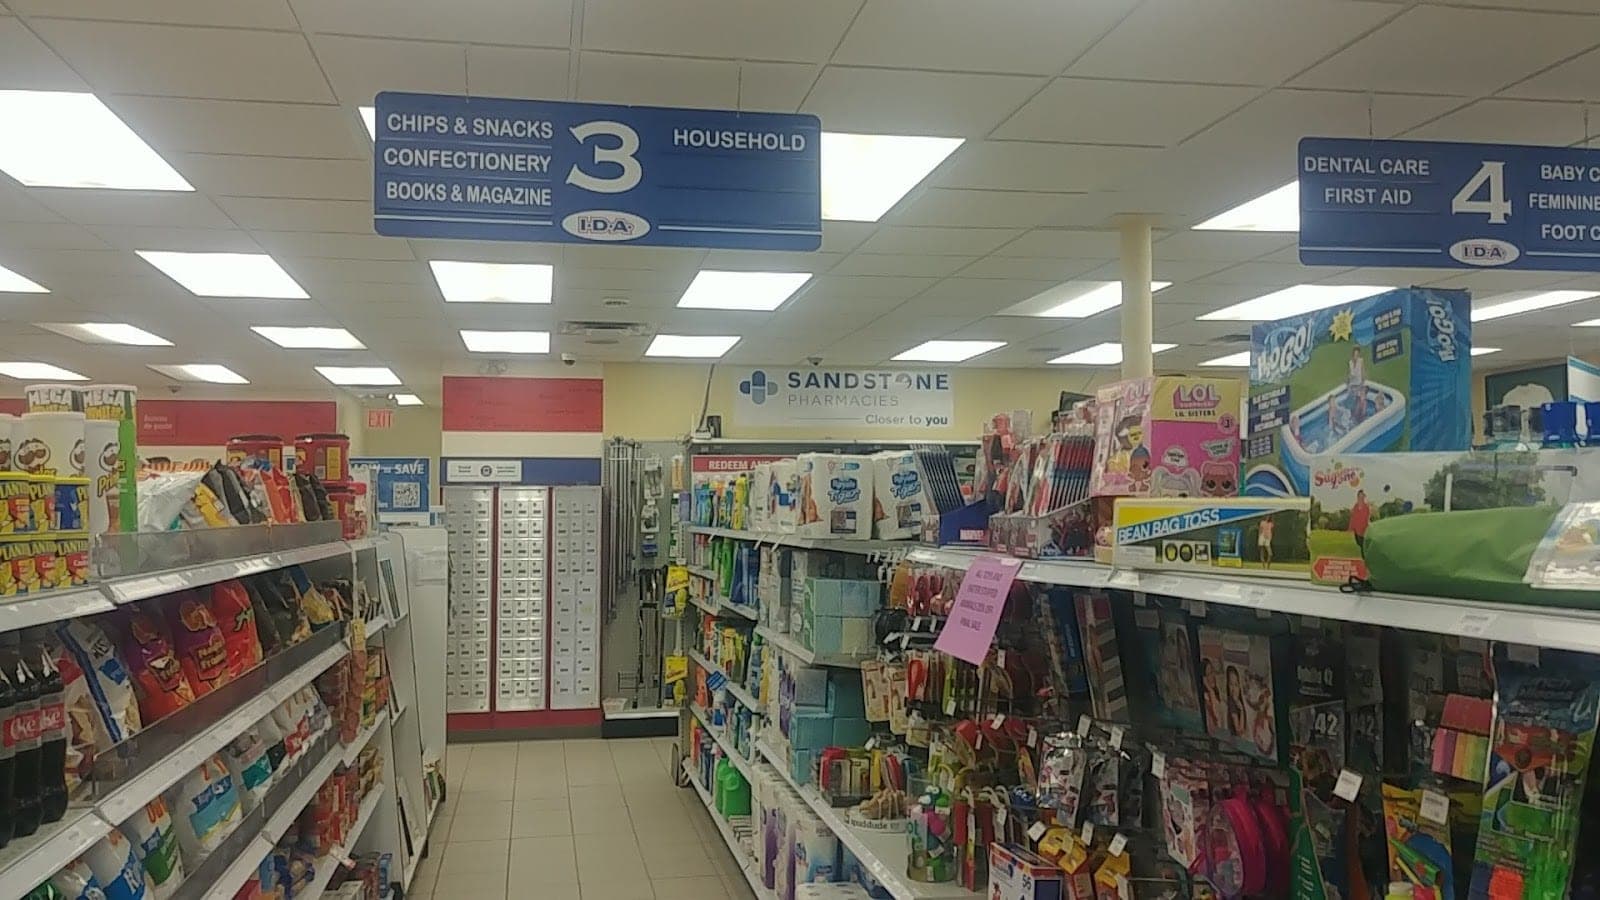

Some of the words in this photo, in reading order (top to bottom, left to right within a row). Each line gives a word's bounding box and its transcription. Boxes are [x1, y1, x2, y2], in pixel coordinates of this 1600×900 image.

[387, 113, 449, 134] CHIPS
[453, 117, 469, 133] &
[473, 118, 554, 139] SNACKS
[673, 128, 806, 152] HOUSEHOLD
[383, 147, 552, 174] CONFECTIONERY
[565, 120, 643, 194] 3
[1304, 157, 1376, 175] DENTAL
[1380, 159, 1430, 176] CARE
[1541, 165, 1586, 182] BABY
[386, 182, 447, 202] BOOKS
[451, 185, 463, 202] &
[466, 186, 552, 206] MAGAZINE
[1325, 188, 1377, 205] FIRST
[1381, 188, 1412, 205] AID
[1452, 161, 1512, 224] 4
[1542, 224, 1587, 240] FOOT
[788, 372, 949, 390] SANDSTONE
[788, 394, 899, 407] PHARMACIES
[368, 410, 392, 428] EXIT
[865, 415, 905, 425] Closer
[909, 415, 922, 425] to
[926, 416, 948, 427] you
[394, 463, 425, 475] SAVE
[708, 460, 748, 470] REDEEM
[1118, 523, 1151, 543] BEAN
[1153, 515, 1180, 536] BAG
[1184, 508, 1220, 527] TOSS
